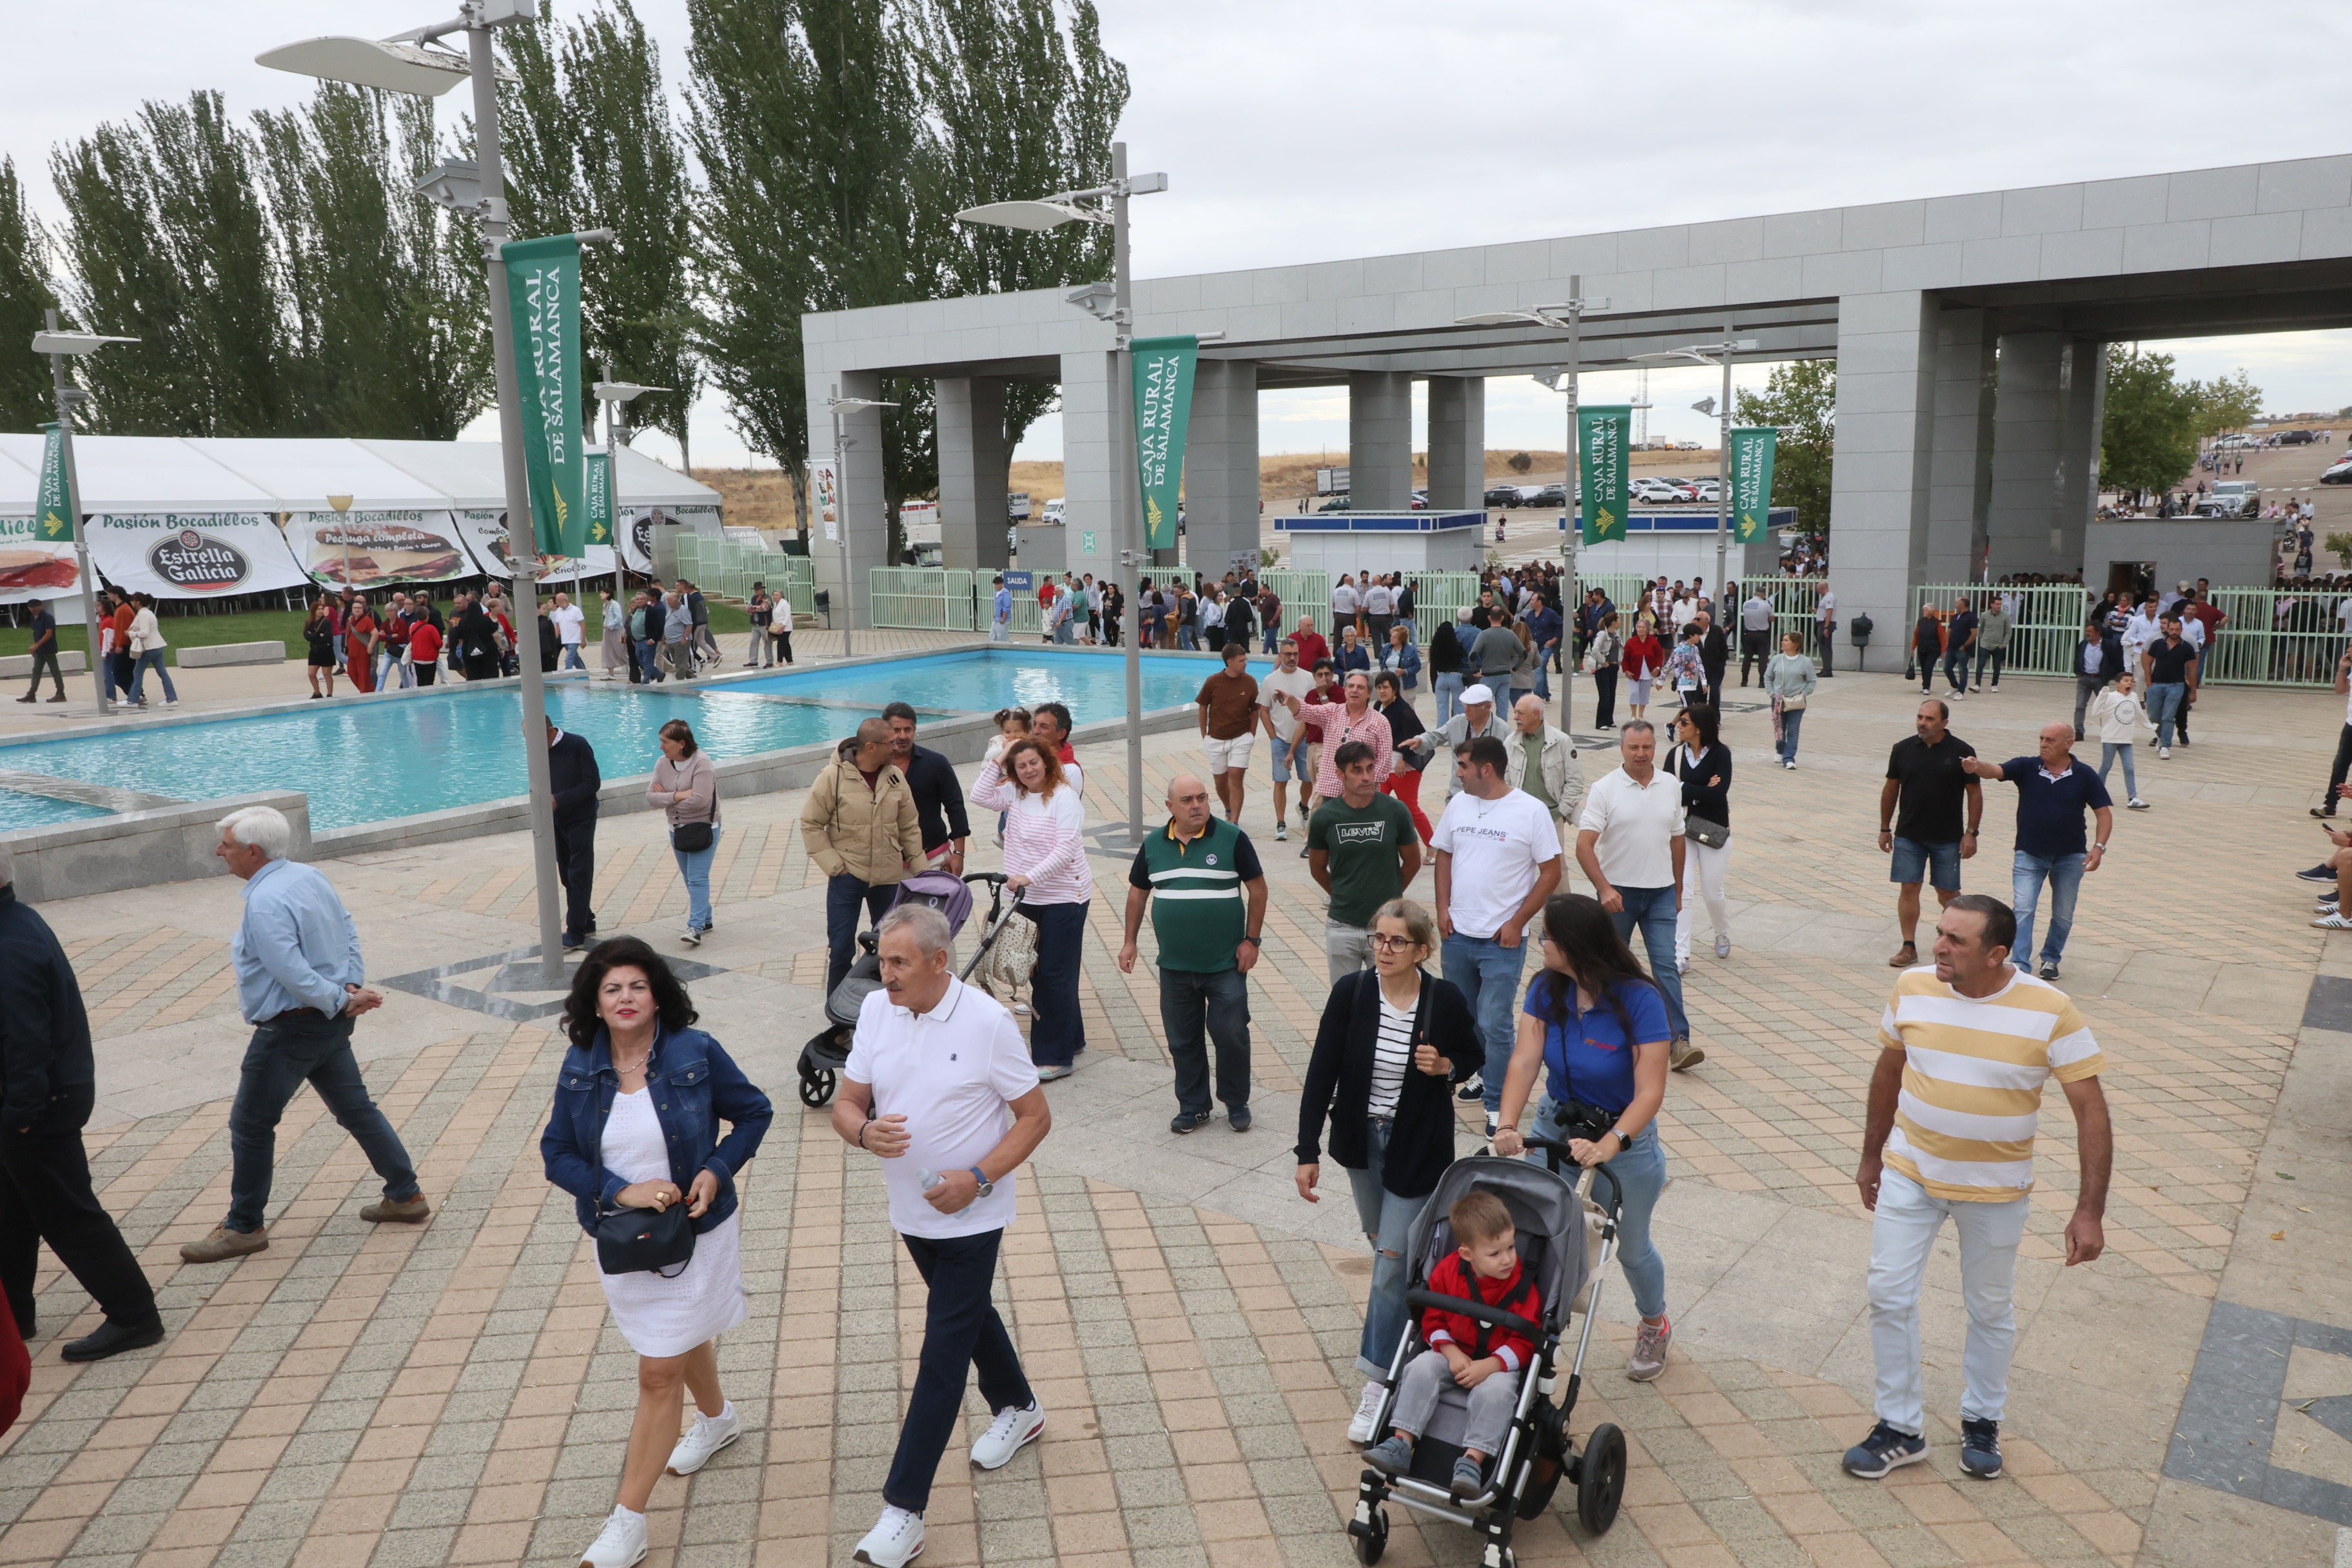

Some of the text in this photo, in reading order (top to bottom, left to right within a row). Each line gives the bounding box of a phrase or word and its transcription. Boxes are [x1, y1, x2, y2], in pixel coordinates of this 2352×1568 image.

[525, 269, 544, 378] RURAL
[546, 266, 565, 464] DE SALAMANCA
[1142, 357, 1164, 487] CAJA RURAL
[1155, 355, 1179, 486] DE SALAMANCA
[44, 433, 57, 507] CAJA RURAL
[1591, 417, 1605, 502] CAJA RURAL
[1606, 417, 1617, 501] DE SALAMANCA
[1740, 438, 1754, 510] CAJA RURAL
[1750, 438, 1764, 509] DE SALAMANCA
[54, 496, 61, 507] DE
[591, 461, 600, 518] CAJA RURAL
[102, 513, 259, 529] Pasión Bocadillos
[355, 511, 423, 524] Bocadillos
[464, 510, 495, 520] Pasión
[598, 508, 605, 518] DE
[373, 531, 425, 543] completa
[159, 548, 235, 565] Estrella
[168, 564, 238, 581] Galicia
[1007, 576, 1027, 585] SALIDA
[1478, 828, 1506, 838] JEANS
